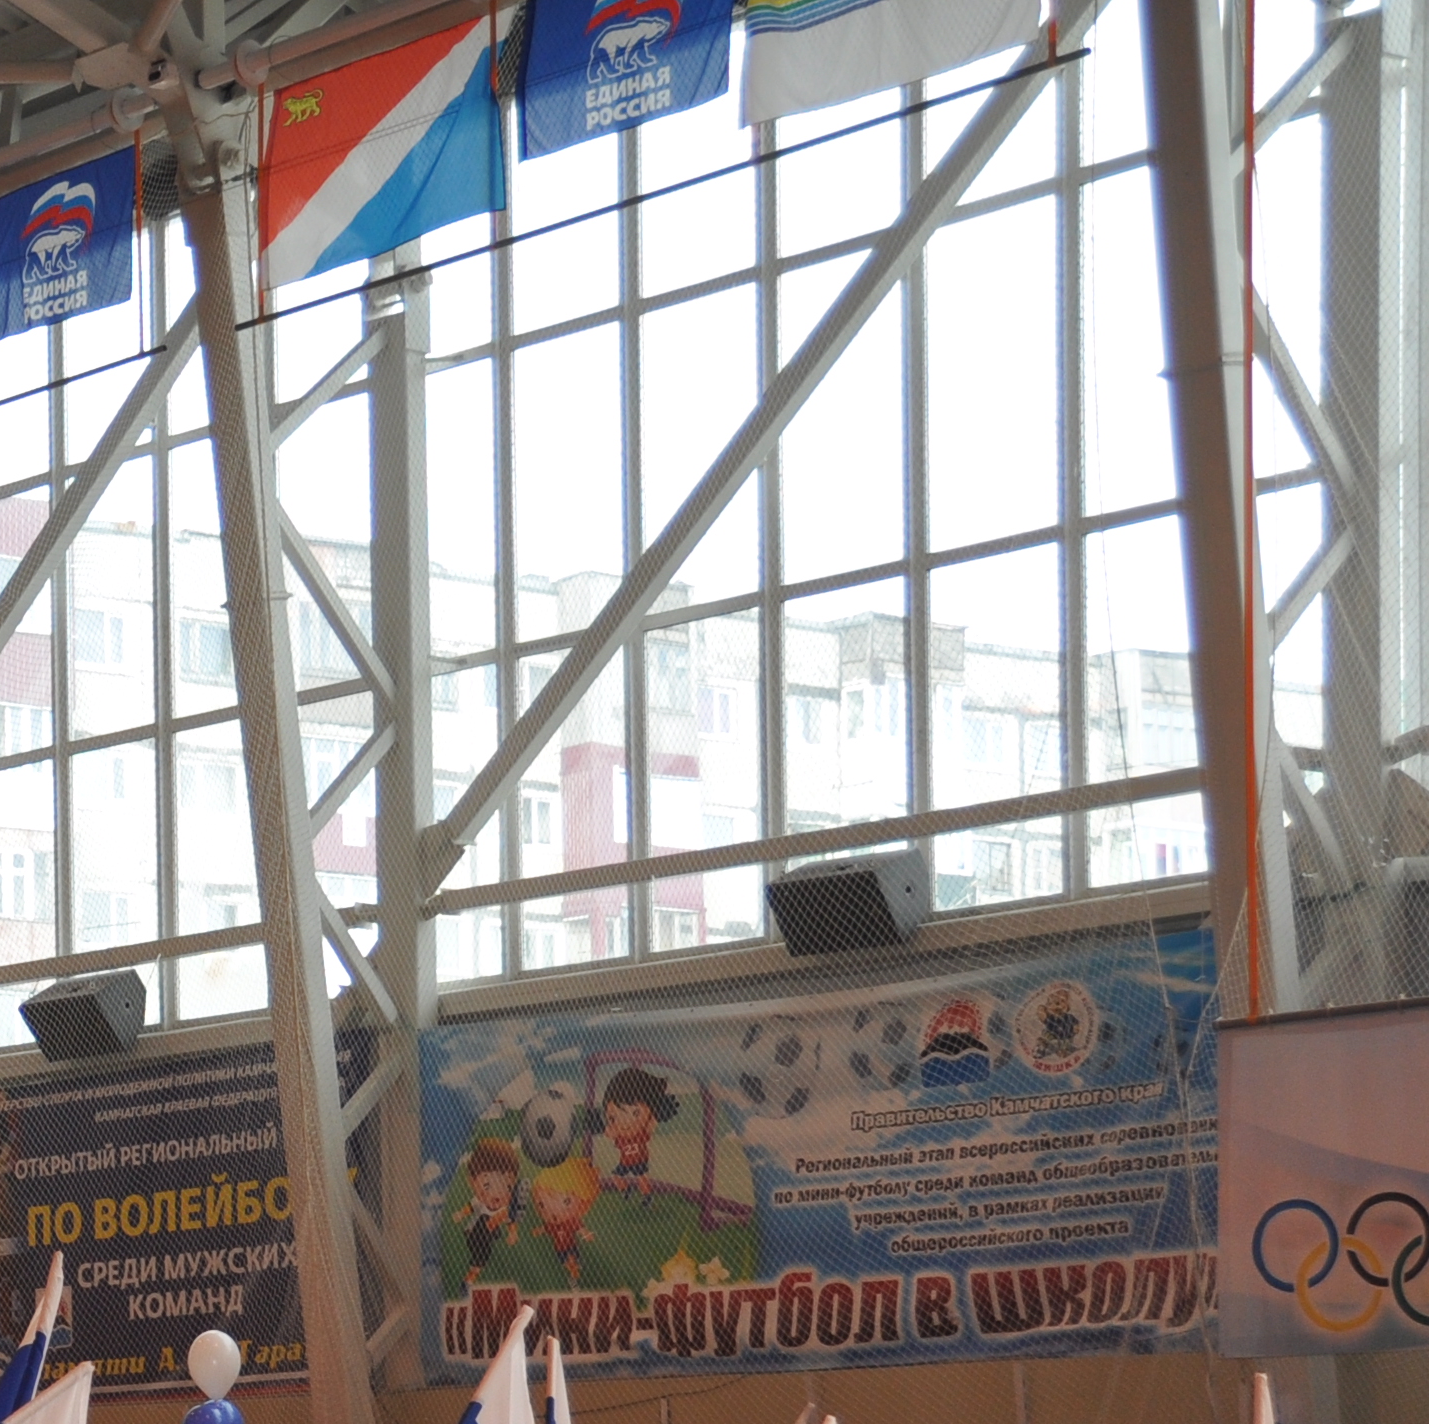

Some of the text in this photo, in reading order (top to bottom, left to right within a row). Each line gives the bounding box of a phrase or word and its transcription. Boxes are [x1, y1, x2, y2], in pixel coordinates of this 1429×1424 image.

[586, 65, 671, 109] ЕДИНАЯ
[586, 88, 671, 131] РОССИЯ
[23, 269, 88, 304] ЕДИНАЯ
[24, 290, 88, 324] РОССИЯ
[851, 1080, 1165, 1131] Правительство Камчатского края
[13, 1121, 278, 1180] ОТКРЫТЫЙ РЕГИОНАЛЬНЫЙ
[795, 1118, 1218, 1174] Региональный этап всероссийских соревновани
[774, 1150, 1218, 1206] по мини-футболу среди команд общеобразователь
[28, 1172, 293, 1246] ПО ВОЛЕЙБО
[854, 1184, 1165, 1231] учреждений, в рамках реализации
[891, 1219, 1129, 1255] общероссийского проекта
[77, 1242, 298, 1289] СРЕДИ МУЖСКИХ
[128, 1285, 243, 1320] КОМАНД
[238, 1340, 305, 1369] Тара
